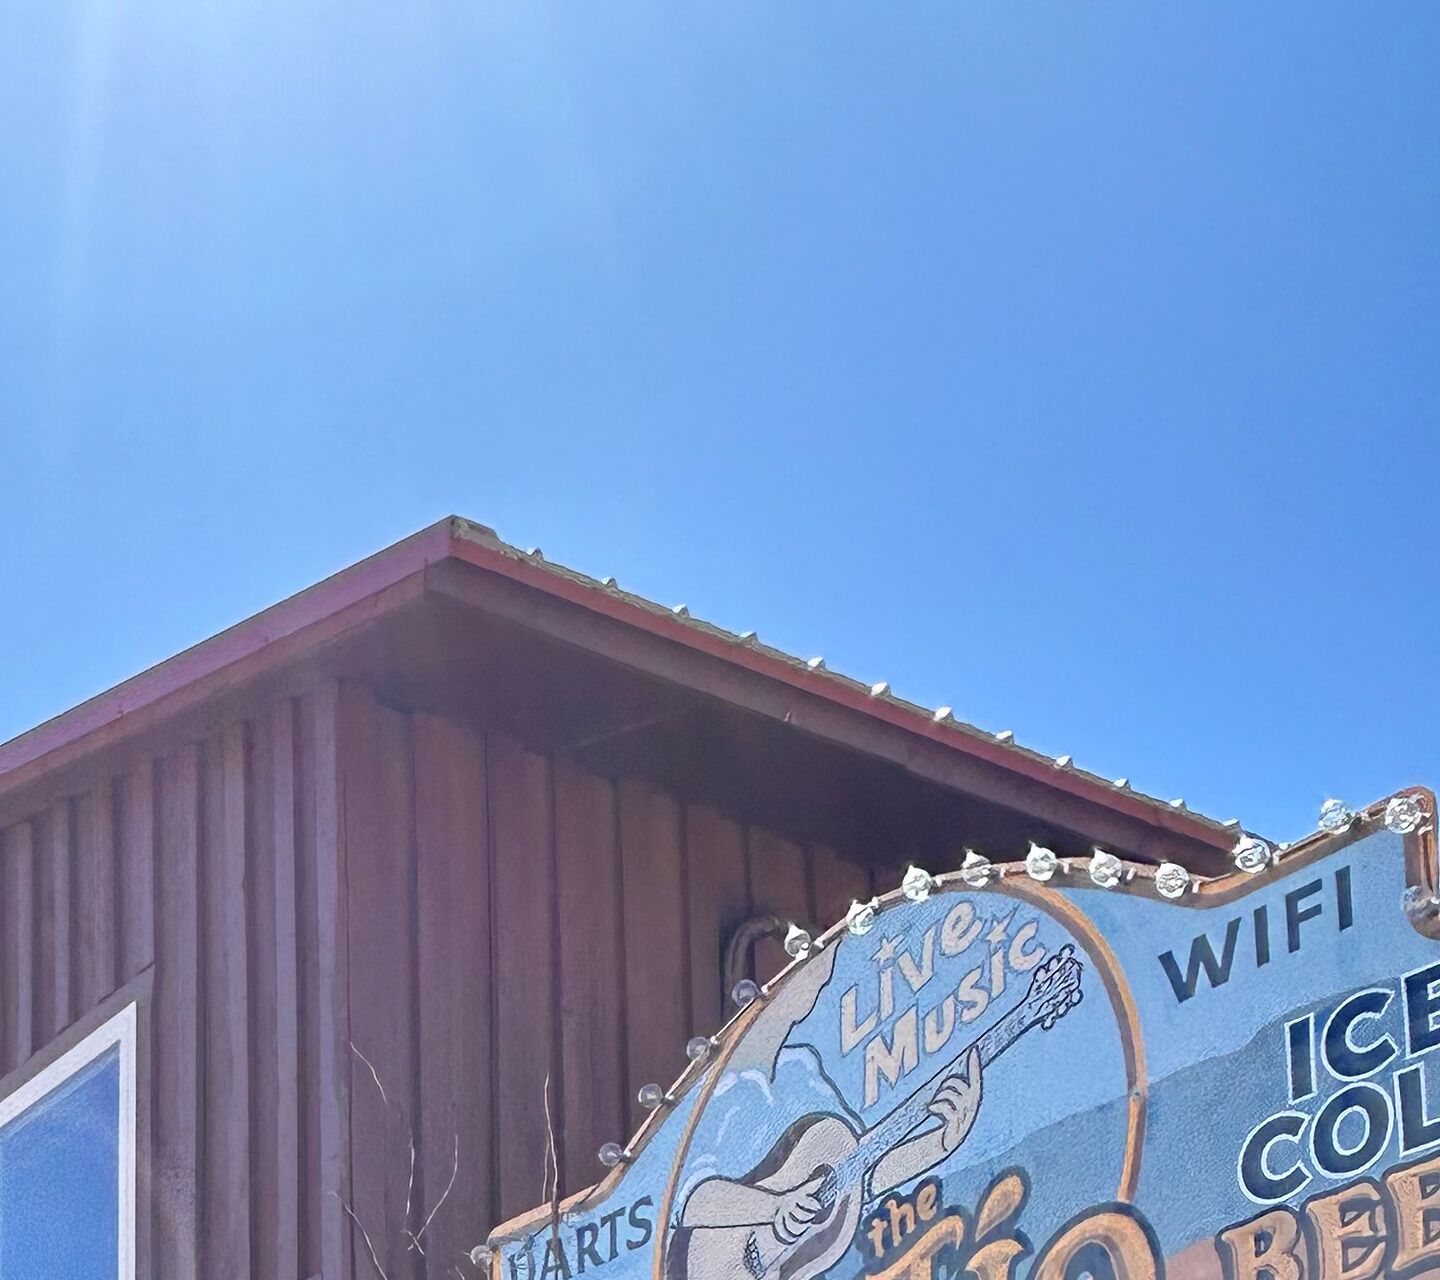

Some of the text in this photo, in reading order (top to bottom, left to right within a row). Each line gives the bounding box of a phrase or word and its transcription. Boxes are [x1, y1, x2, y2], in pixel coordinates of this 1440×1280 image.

[839, 900, 985, 1058] Live
[1157, 865, 1354, 1004] WIFI
[862, 918, 1047, 1109] Music
[1283, 962, 1440, 1105] ICE
[866, 1182, 940, 1258] the
